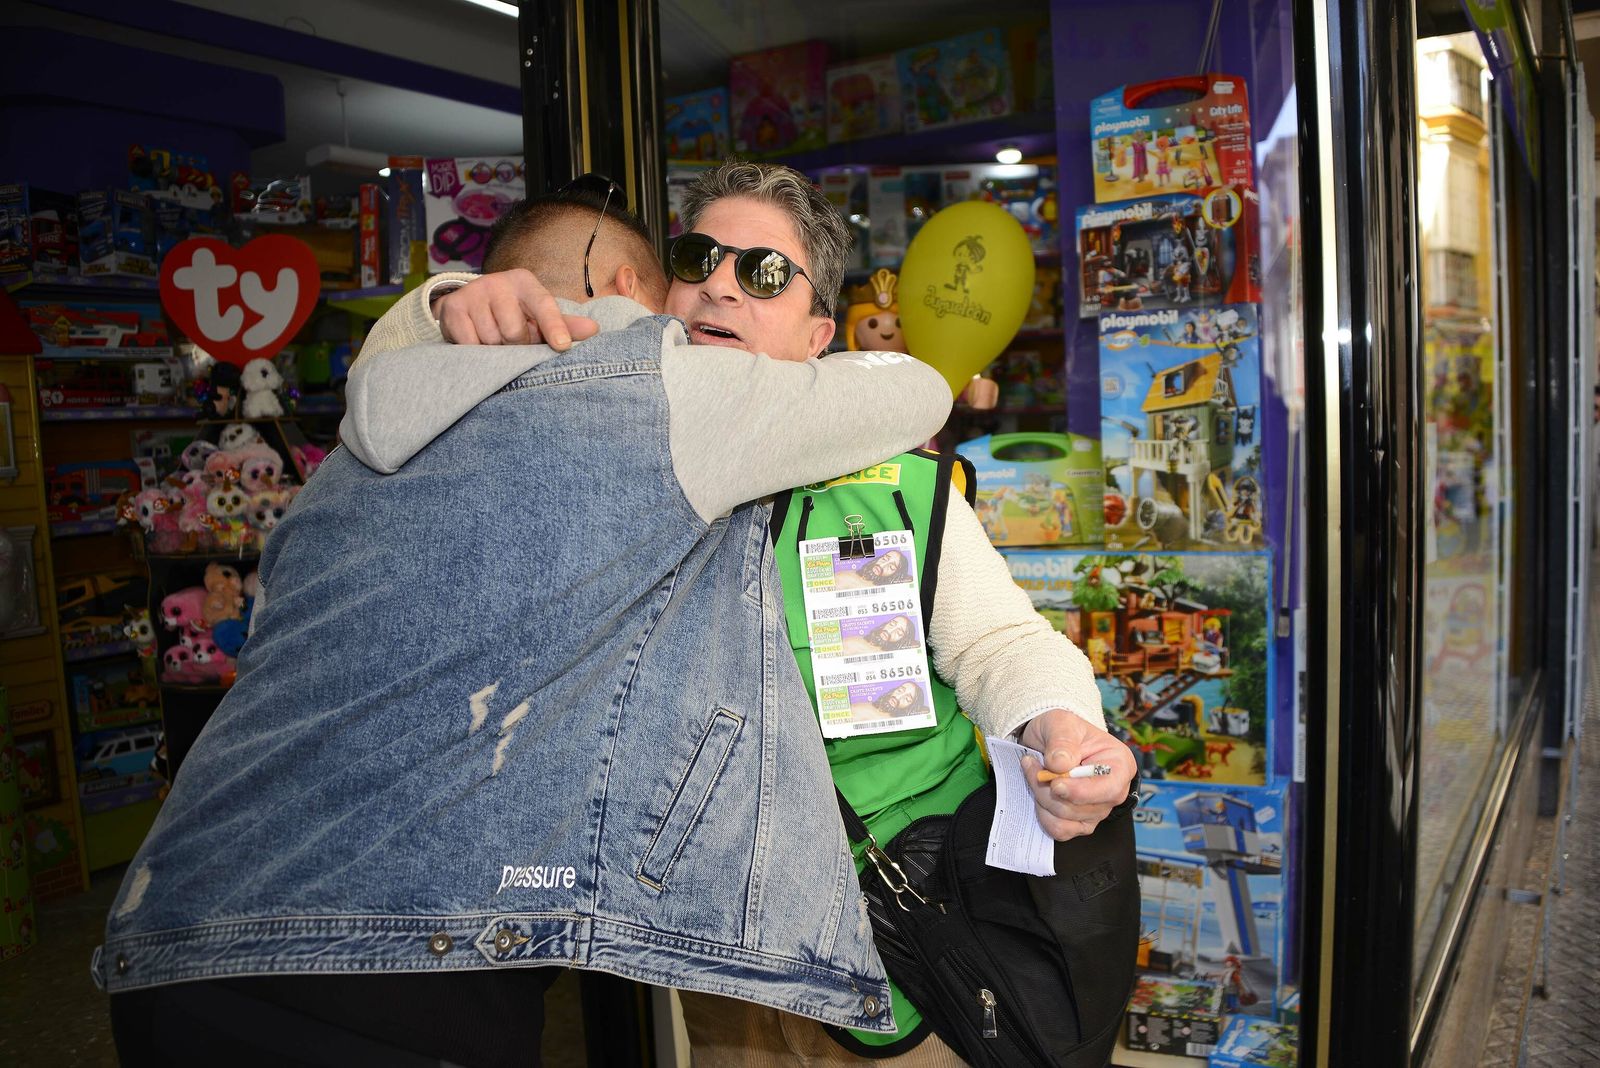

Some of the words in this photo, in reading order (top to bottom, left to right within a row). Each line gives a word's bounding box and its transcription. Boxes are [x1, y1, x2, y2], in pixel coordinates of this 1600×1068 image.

[1094, 115, 1150, 136] playmobil
[1081, 202, 1153, 228] playmobil
[172, 246, 300, 351] ty
[1100, 309, 1179, 332] playmobil
[845, 466, 894, 481] NCE
[874, 533, 908, 547] 6506
[1011, 557, 1074, 578] mobil
[871, 598, 914, 613] 86506
[880, 664, 923, 680] 86506
[496, 865, 577, 895] pressure
